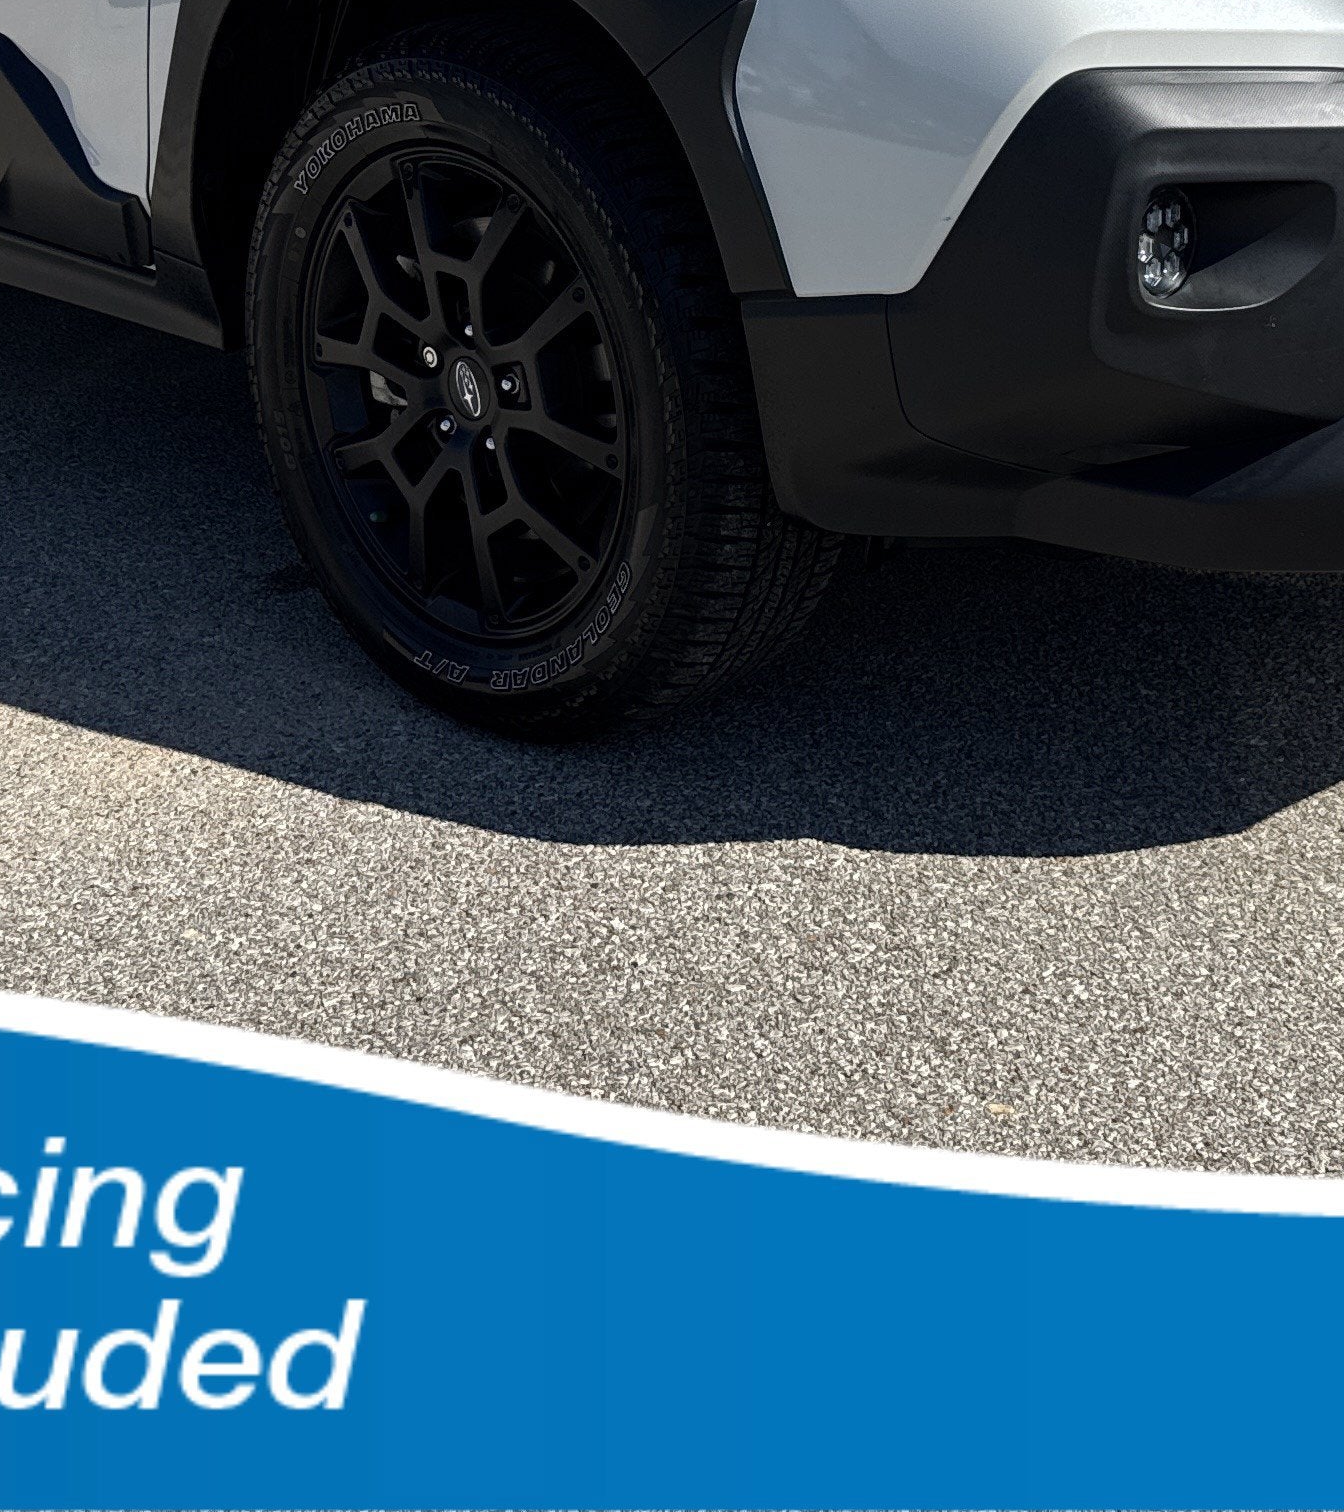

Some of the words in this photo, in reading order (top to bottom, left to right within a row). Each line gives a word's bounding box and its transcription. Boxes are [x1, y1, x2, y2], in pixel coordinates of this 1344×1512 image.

[293, 103, 421, 195] YOKOHAMA
[413, 649, 470, 684] A/T
[490, 560, 631, 690] GEOLANDAR
